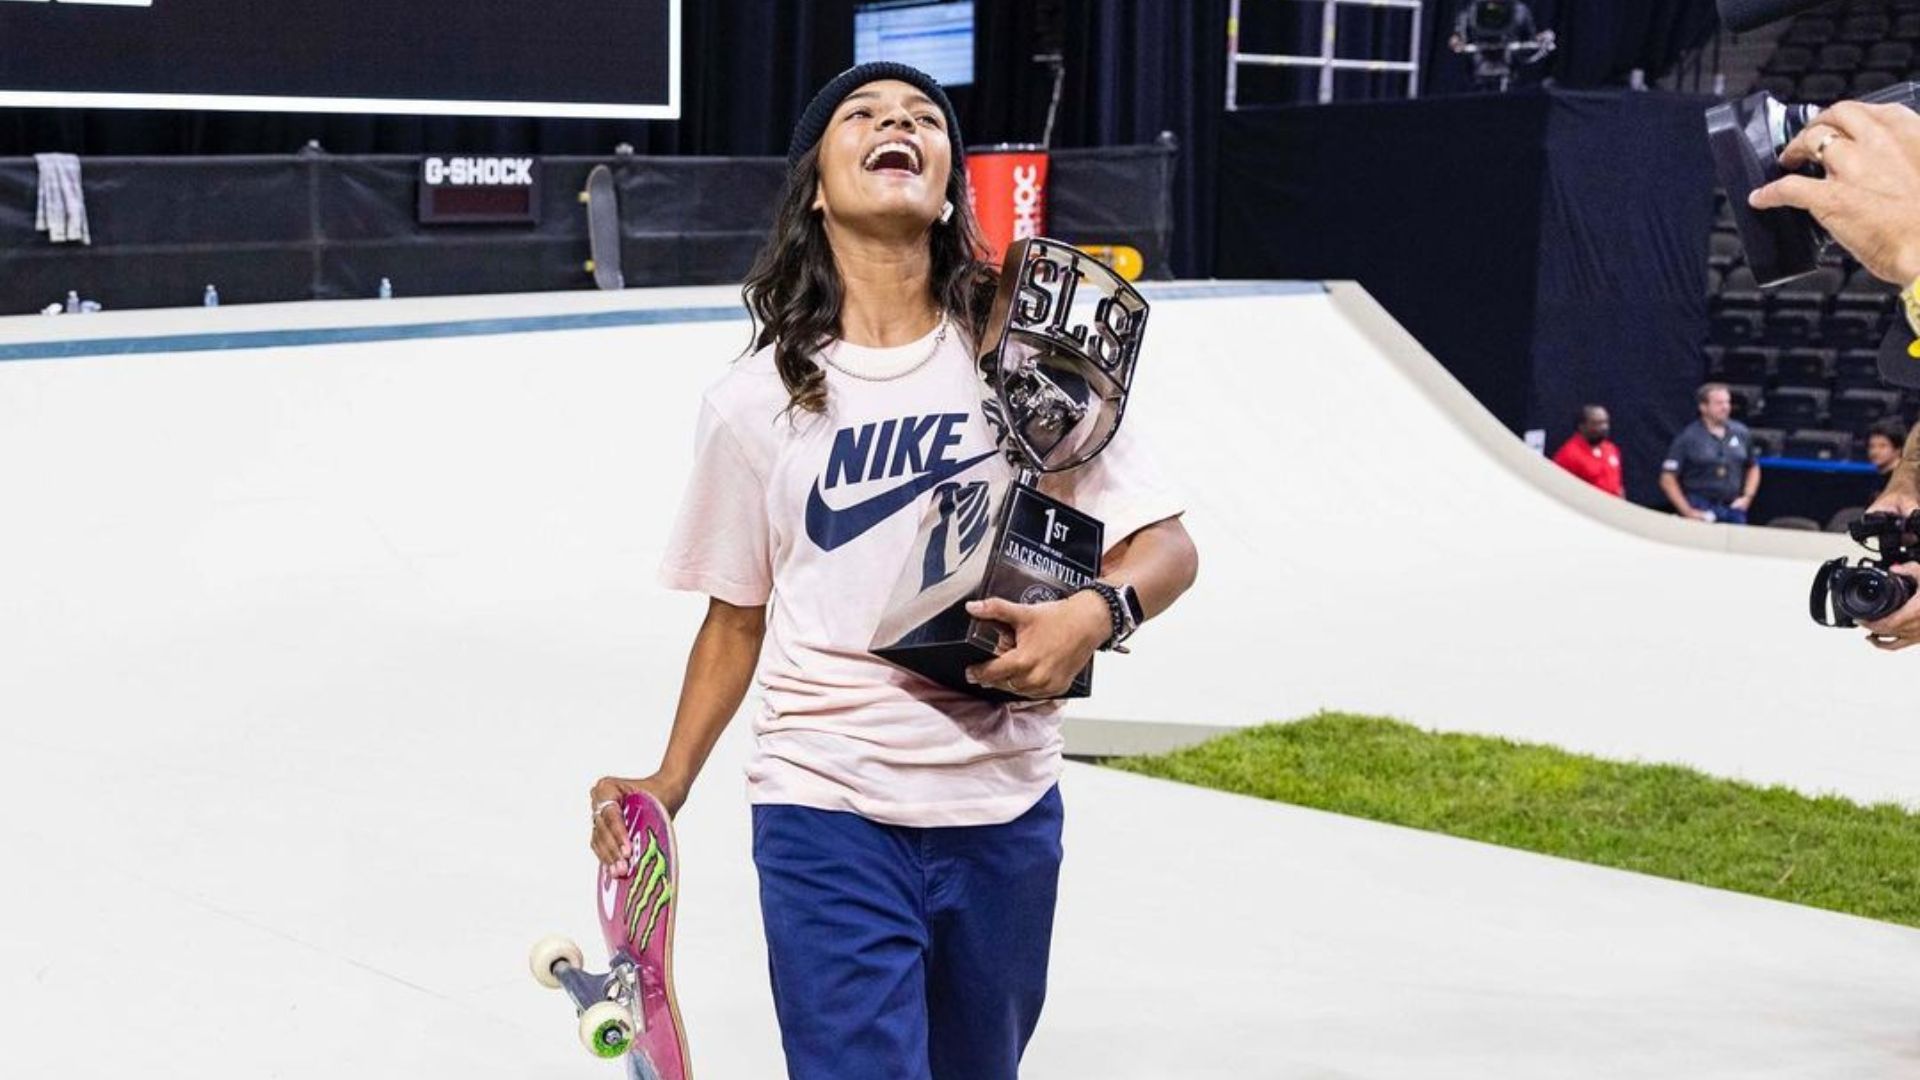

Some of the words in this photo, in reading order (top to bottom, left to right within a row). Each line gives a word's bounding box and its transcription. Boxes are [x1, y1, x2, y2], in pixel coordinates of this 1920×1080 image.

[425, 157, 533, 185] G-SHOCK
[1018, 256, 1131, 371] SLS
[825, 413, 969, 489] NIKE
[1045, 508, 1070, 545] 1ST
